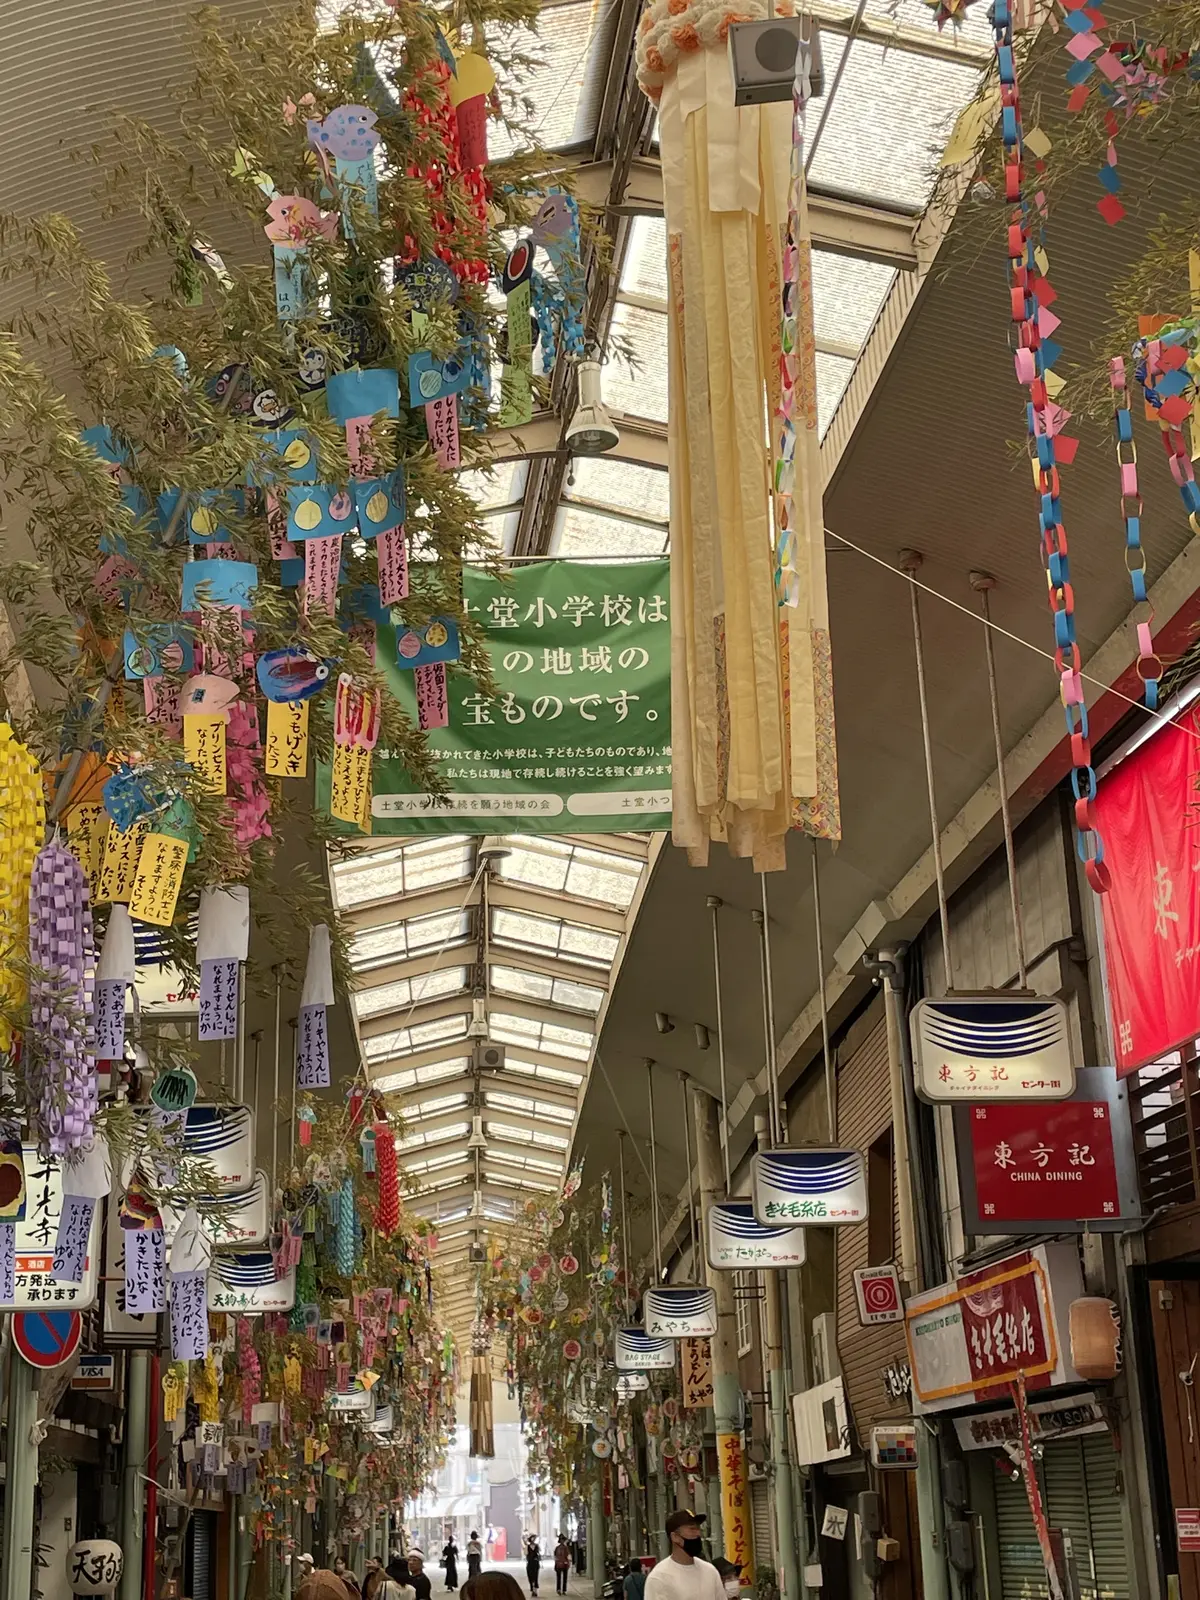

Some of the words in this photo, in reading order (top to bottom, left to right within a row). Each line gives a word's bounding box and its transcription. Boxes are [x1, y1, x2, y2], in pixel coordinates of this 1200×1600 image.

[488, 645, 650, 676] の地域の
[461, 689, 659, 726] 宝ものです。
[210, 720, 225, 785] プリンセスに
[131, 874, 147, 912] そらと
[143, 842, 168, 917] なれますように
[212, 964, 223, 1031] なれますように
[200, 1000, 211, 1035] ゆたか
[314, 1010, 328, 1084] ケーキやさんに
[939, 1064, 1009, 1083] 東方記
[993, 1140, 1096, 1169] 東方記
[1010, 1172, 1041, 1182] CHINA
[1046, 1171, 1083, 1181] DINING
[764, 1201, 828, 1219] きそ毛糸店
[66, 1203, 80, 1259] なりたいな
[52, 1245, 65, 1271] ゆの
[136, 1233, 149, 1294] かきたいな
[27, 1288, 80, 1301] 承ります
[127, 1278, 138, 1308] りこ
[650, 1321, 691, 1334] みやち
[81, 1367, 104, 1377] VISA
[624, 1353, 639, 1361] BAG
[640, 1353, 661, 1361] STAGE
[725, 1438, 744, 1508] 中華そば
